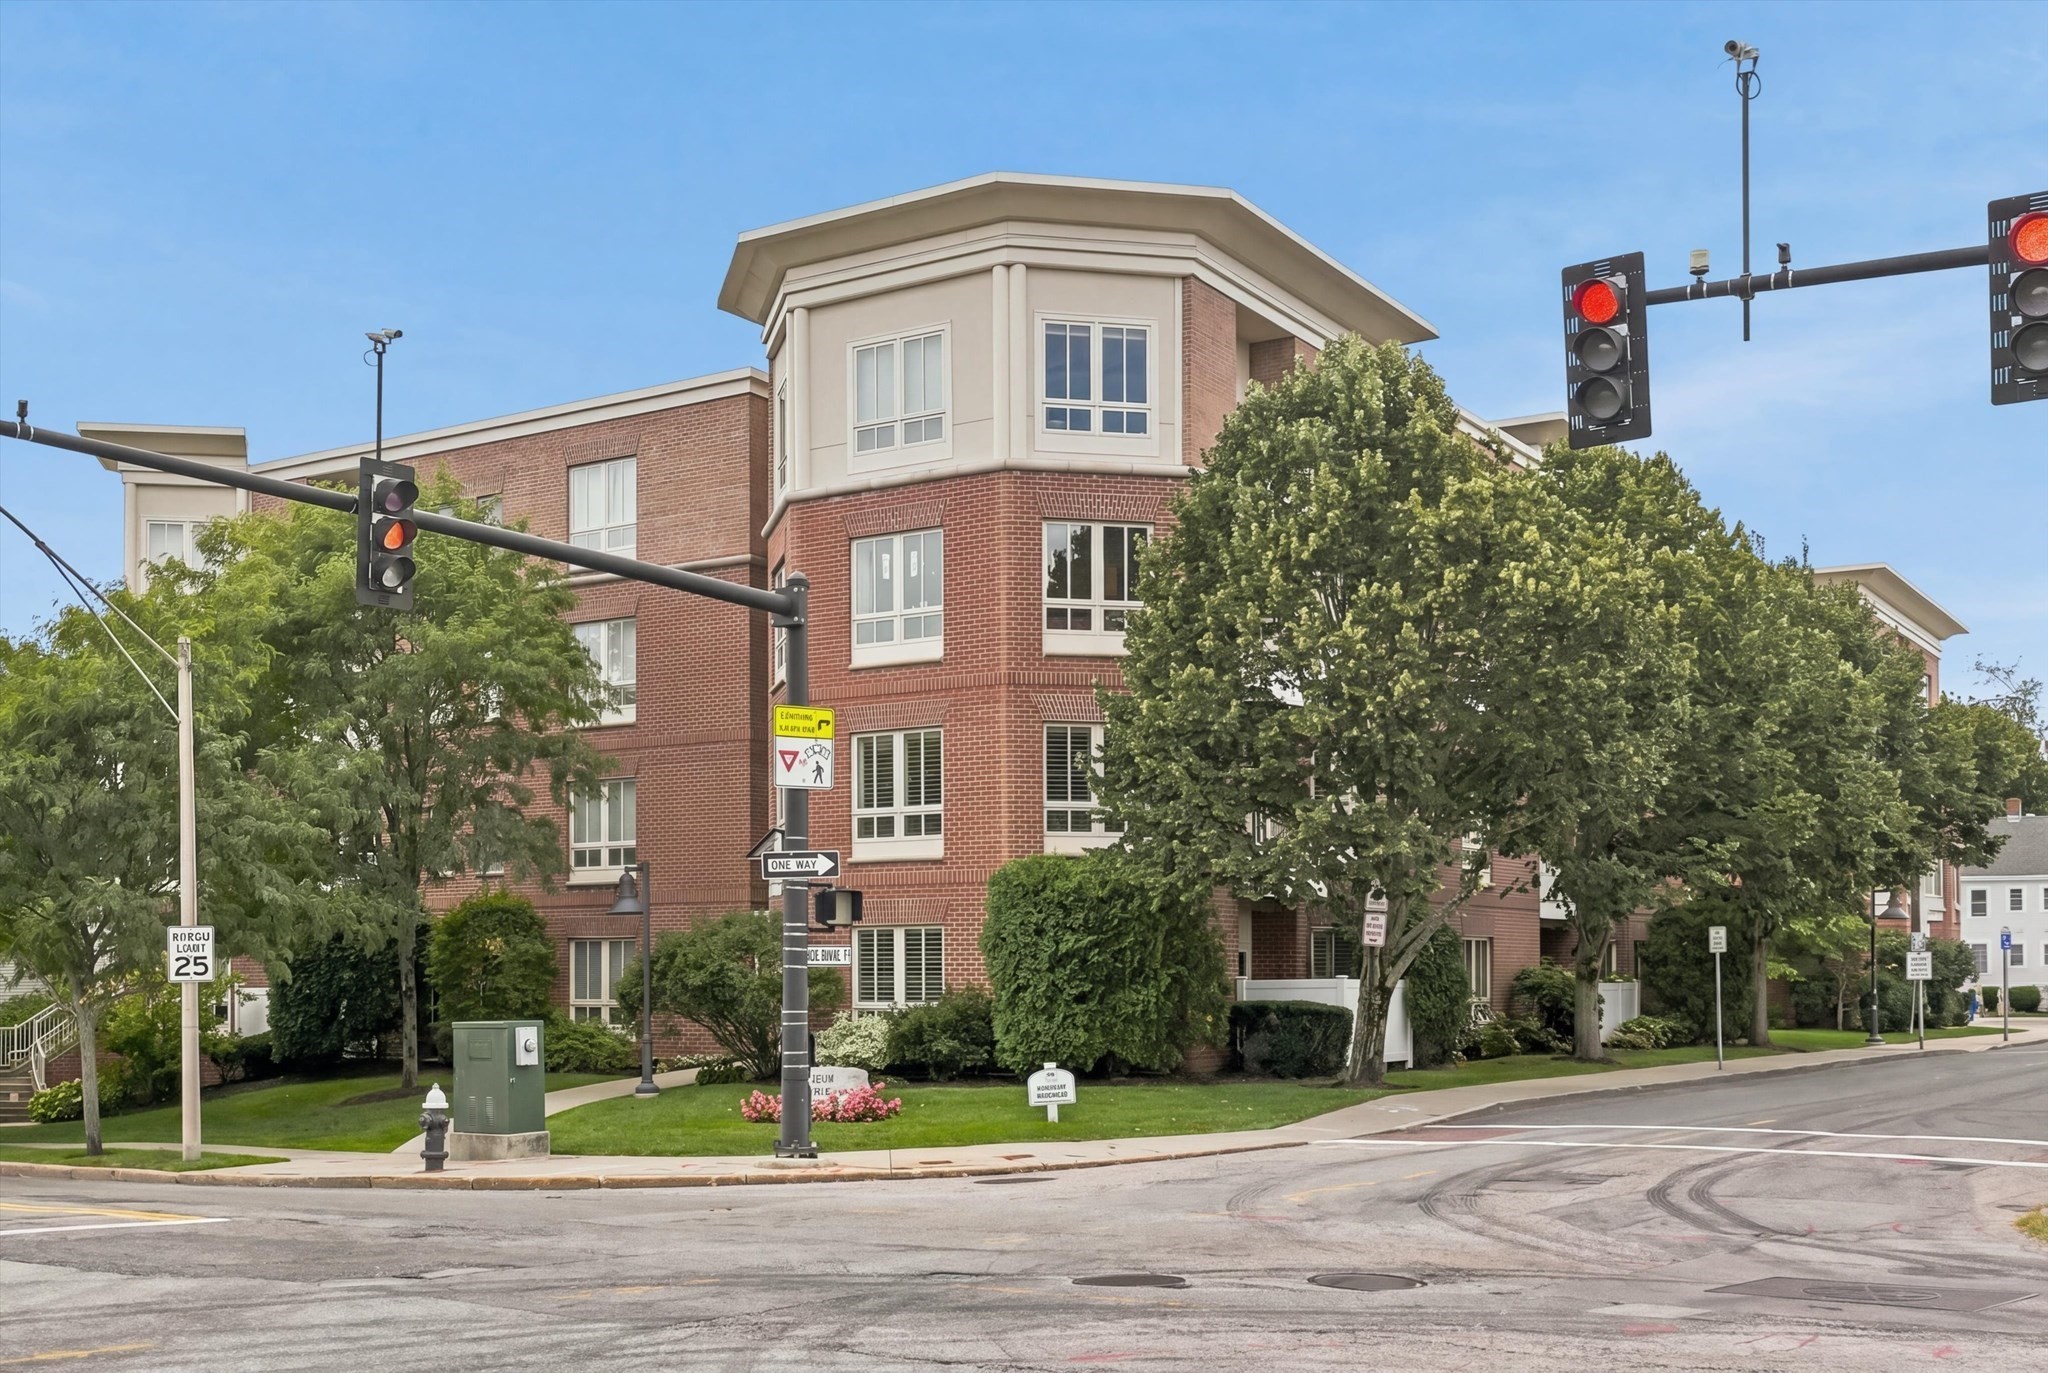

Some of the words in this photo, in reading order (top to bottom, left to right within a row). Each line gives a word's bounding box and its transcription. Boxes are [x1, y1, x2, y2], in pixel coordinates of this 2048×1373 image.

[771, 860, 791, 870] ONE
[796, 860, 817, 869] WAY
[174, 955, 209, 977] 25
